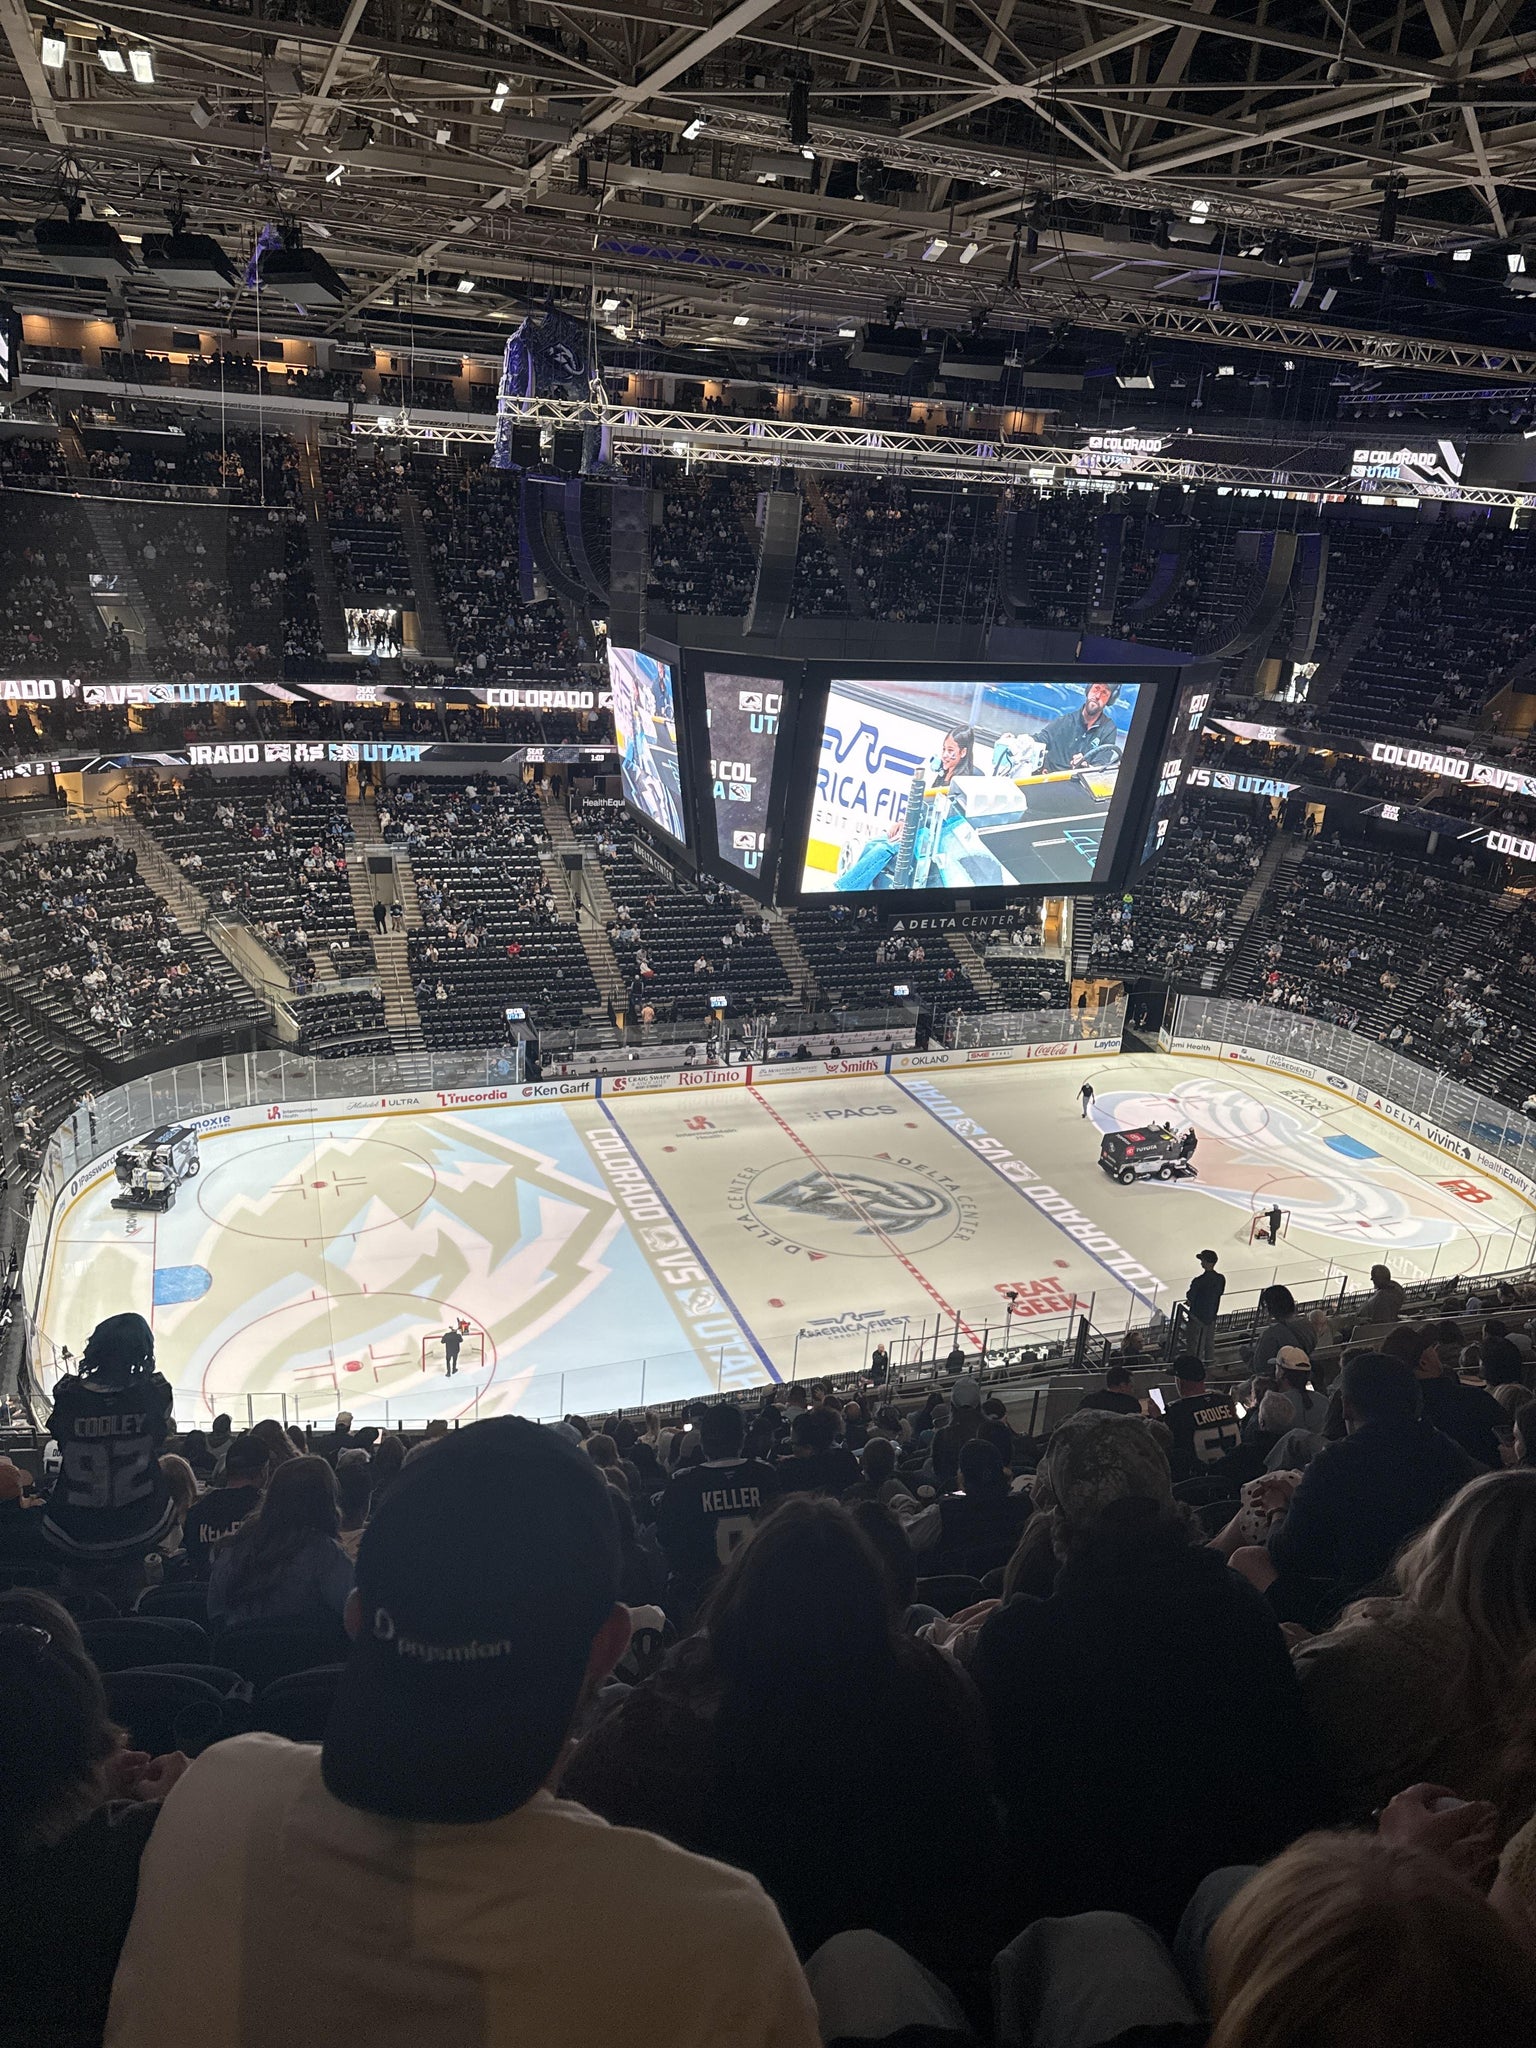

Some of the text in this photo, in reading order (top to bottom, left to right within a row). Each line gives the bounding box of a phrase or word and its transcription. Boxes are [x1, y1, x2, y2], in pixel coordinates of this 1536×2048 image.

[1103, 437, 1162, 452] COLORADO
[1369, 450, 1437, 466] COLORADO
[1367, 466, 1401, 479] UTAH
[0, 679, 240, 705] ADO VS UTAH
[486, 688, 594, 709] COLORADO
[765, 694, 783, 714] C
[750, 713, 780, 735] UT
[363, 744, 421, 763] UTAH
[719, 761, 757, 783] COL
[1372, 742, 1519, 793] COLORADO VS
[1237, 775, 1290, 799] UTAH
[582, 798, 626, 808] HealthEqui
[1486, 830, 1536, 862] COLO
[637, 844, 673, 883] DELTA CENTER
[908, 915, 1014, 930] DELTA CENTER
[1094, 1040, 1121, 1050] Layton
[1186, 1042, 1211, 1052] Health
[911, 1055, 949, 1066] OKLAND
[970, 1052, 990, 1060] SME
[839, 1060, 879, 1074] Smith's
[1269, 1059, 1312, 1077] INGREDIENTS
[447, 1089, 508, 1104] Trucordia
[534, 1082, 590, 1097] Ken Garff
[905, 1078, 965, 1118] UTAH
[388, 1098, 420, 1107] ULTRA
[823, 1105, 898, 1120] PACS
[190, 1115, 231, 1130] moxie
[967, 1136, 1014, 1164] VS
[1136, 1144, 1157, 1153] TOYOTA
[1385, 1104, 1422, 1131] DELTA
[1476, 1152, 1529, 1192] HealthEquity
[77, 1153, 118, 1188] 1Password
[585, 1127, 670, 1222] COLORADO
[656, 1251, 708, 1285] VS
[896, 1157, 979, 1243] DELTA CENTER
[727, 1166, 801, 1256] CENTER DELTA
[1022, 1184, 1170, 1295] COLORADO
[994, 1276, 1065, 1300] SEAT
[1010, 1293, 1091, 1317] GEEK
[868, 1315, 912, 1329] FIRST
[74, 1413, 147, 1437] COOLEY
[1193, 1404, 1233, 1426] CROUSE
[64, 1436, 155, 1508] 92
[702, 1487, 761, 1513] KELLER
